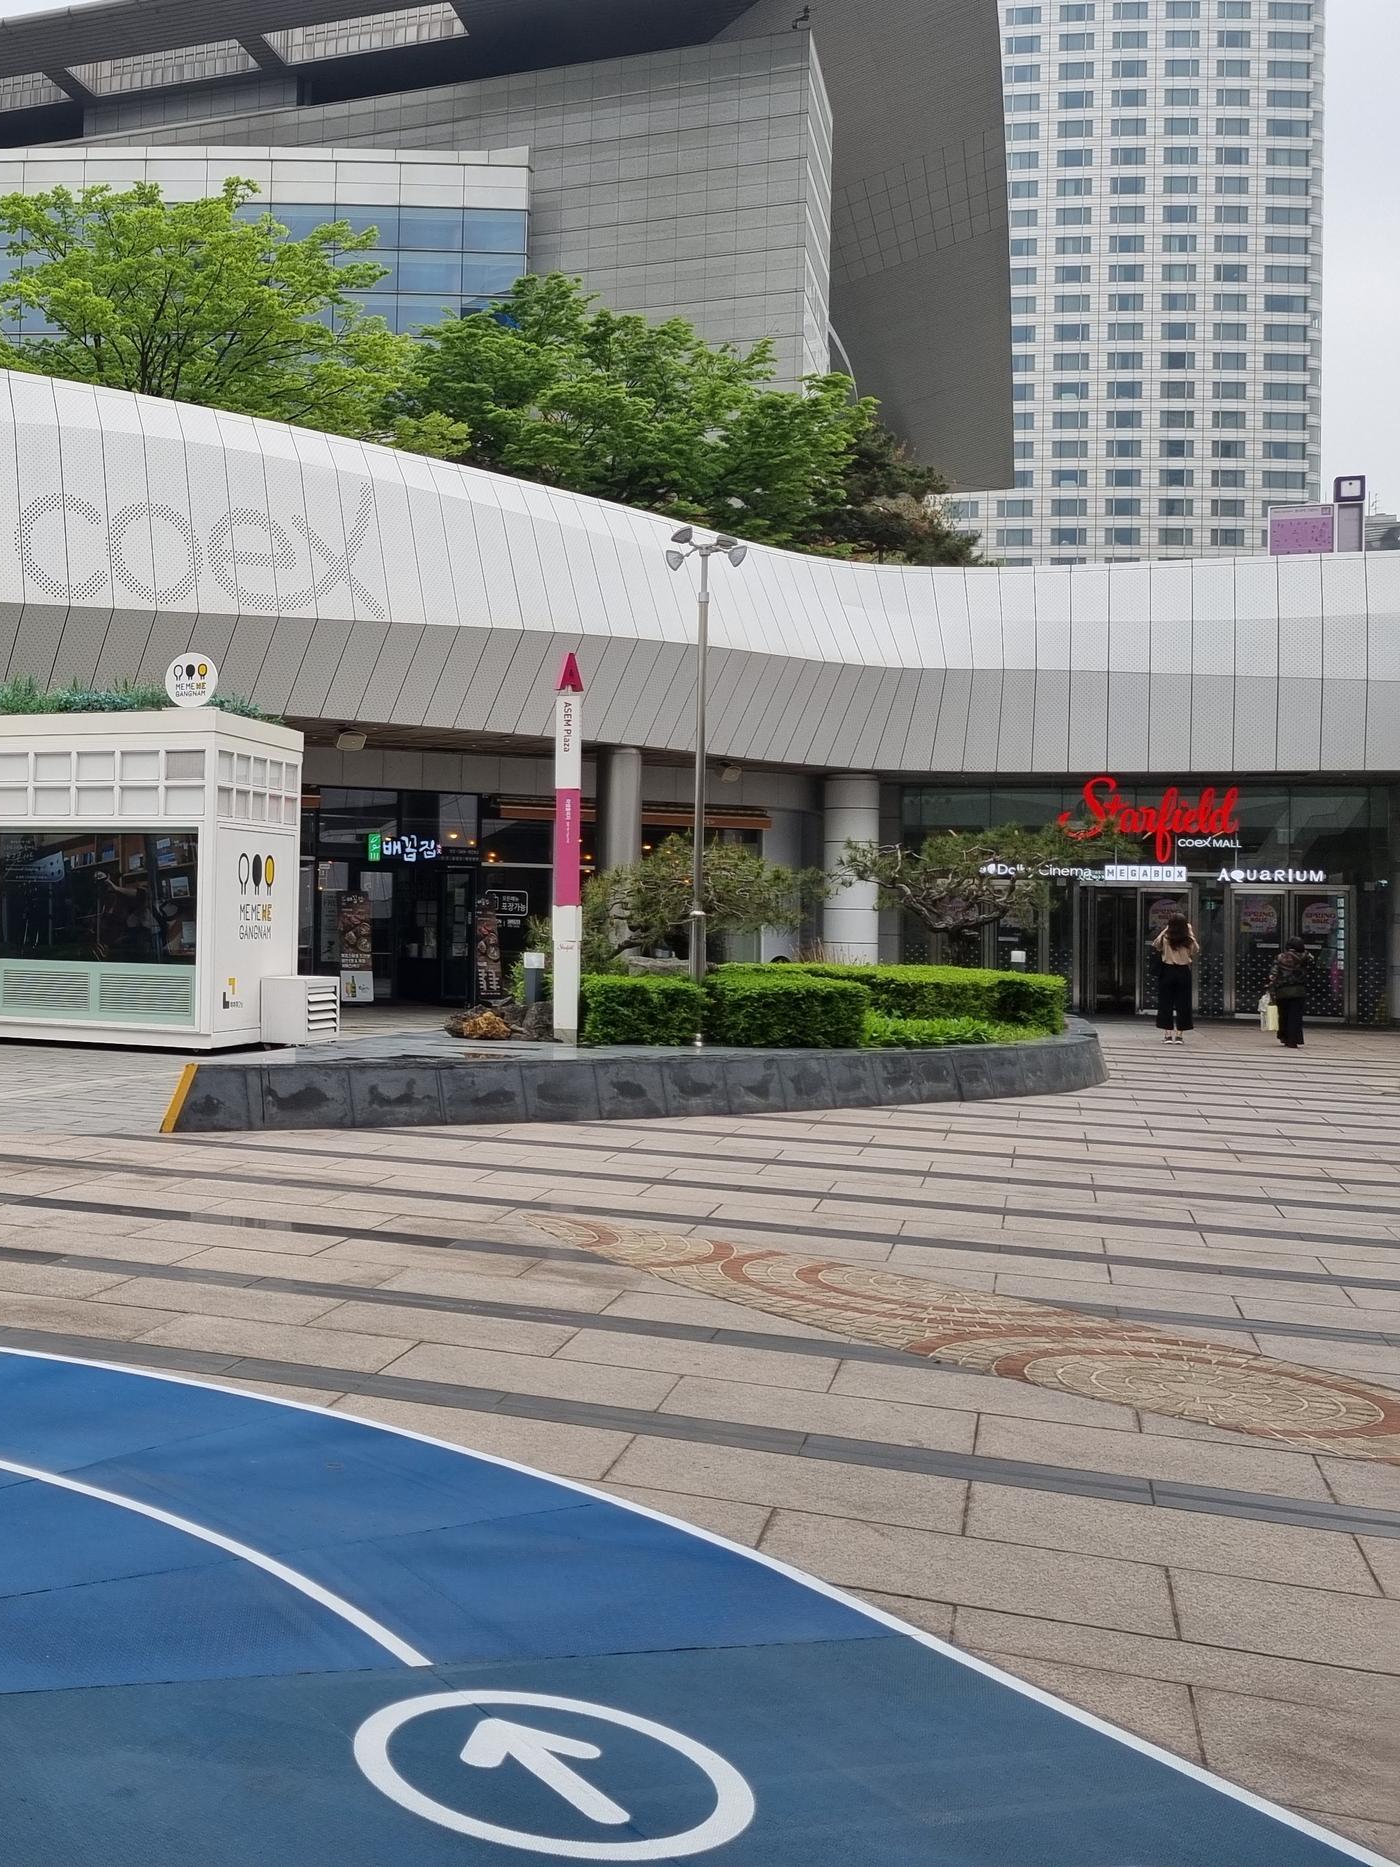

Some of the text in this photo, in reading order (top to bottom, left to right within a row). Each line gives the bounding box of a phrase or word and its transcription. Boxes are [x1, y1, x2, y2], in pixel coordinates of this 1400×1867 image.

[14, 481, 386, 620] coex
[563, 701, 573, 753] ASEM Plaza
[1057, 776, 1241, 864] Starfield
[382, 834, 437, 862] 배꼽집
[1212, 838, 1242, 849] MALL
[1038, 863, 1092, 877] Cinema
[1105, 867, 1185, 880] MEGABOX
[501, 902, 527, 912] 포장가능
[238, 924, 272, 941] GANGNAM
